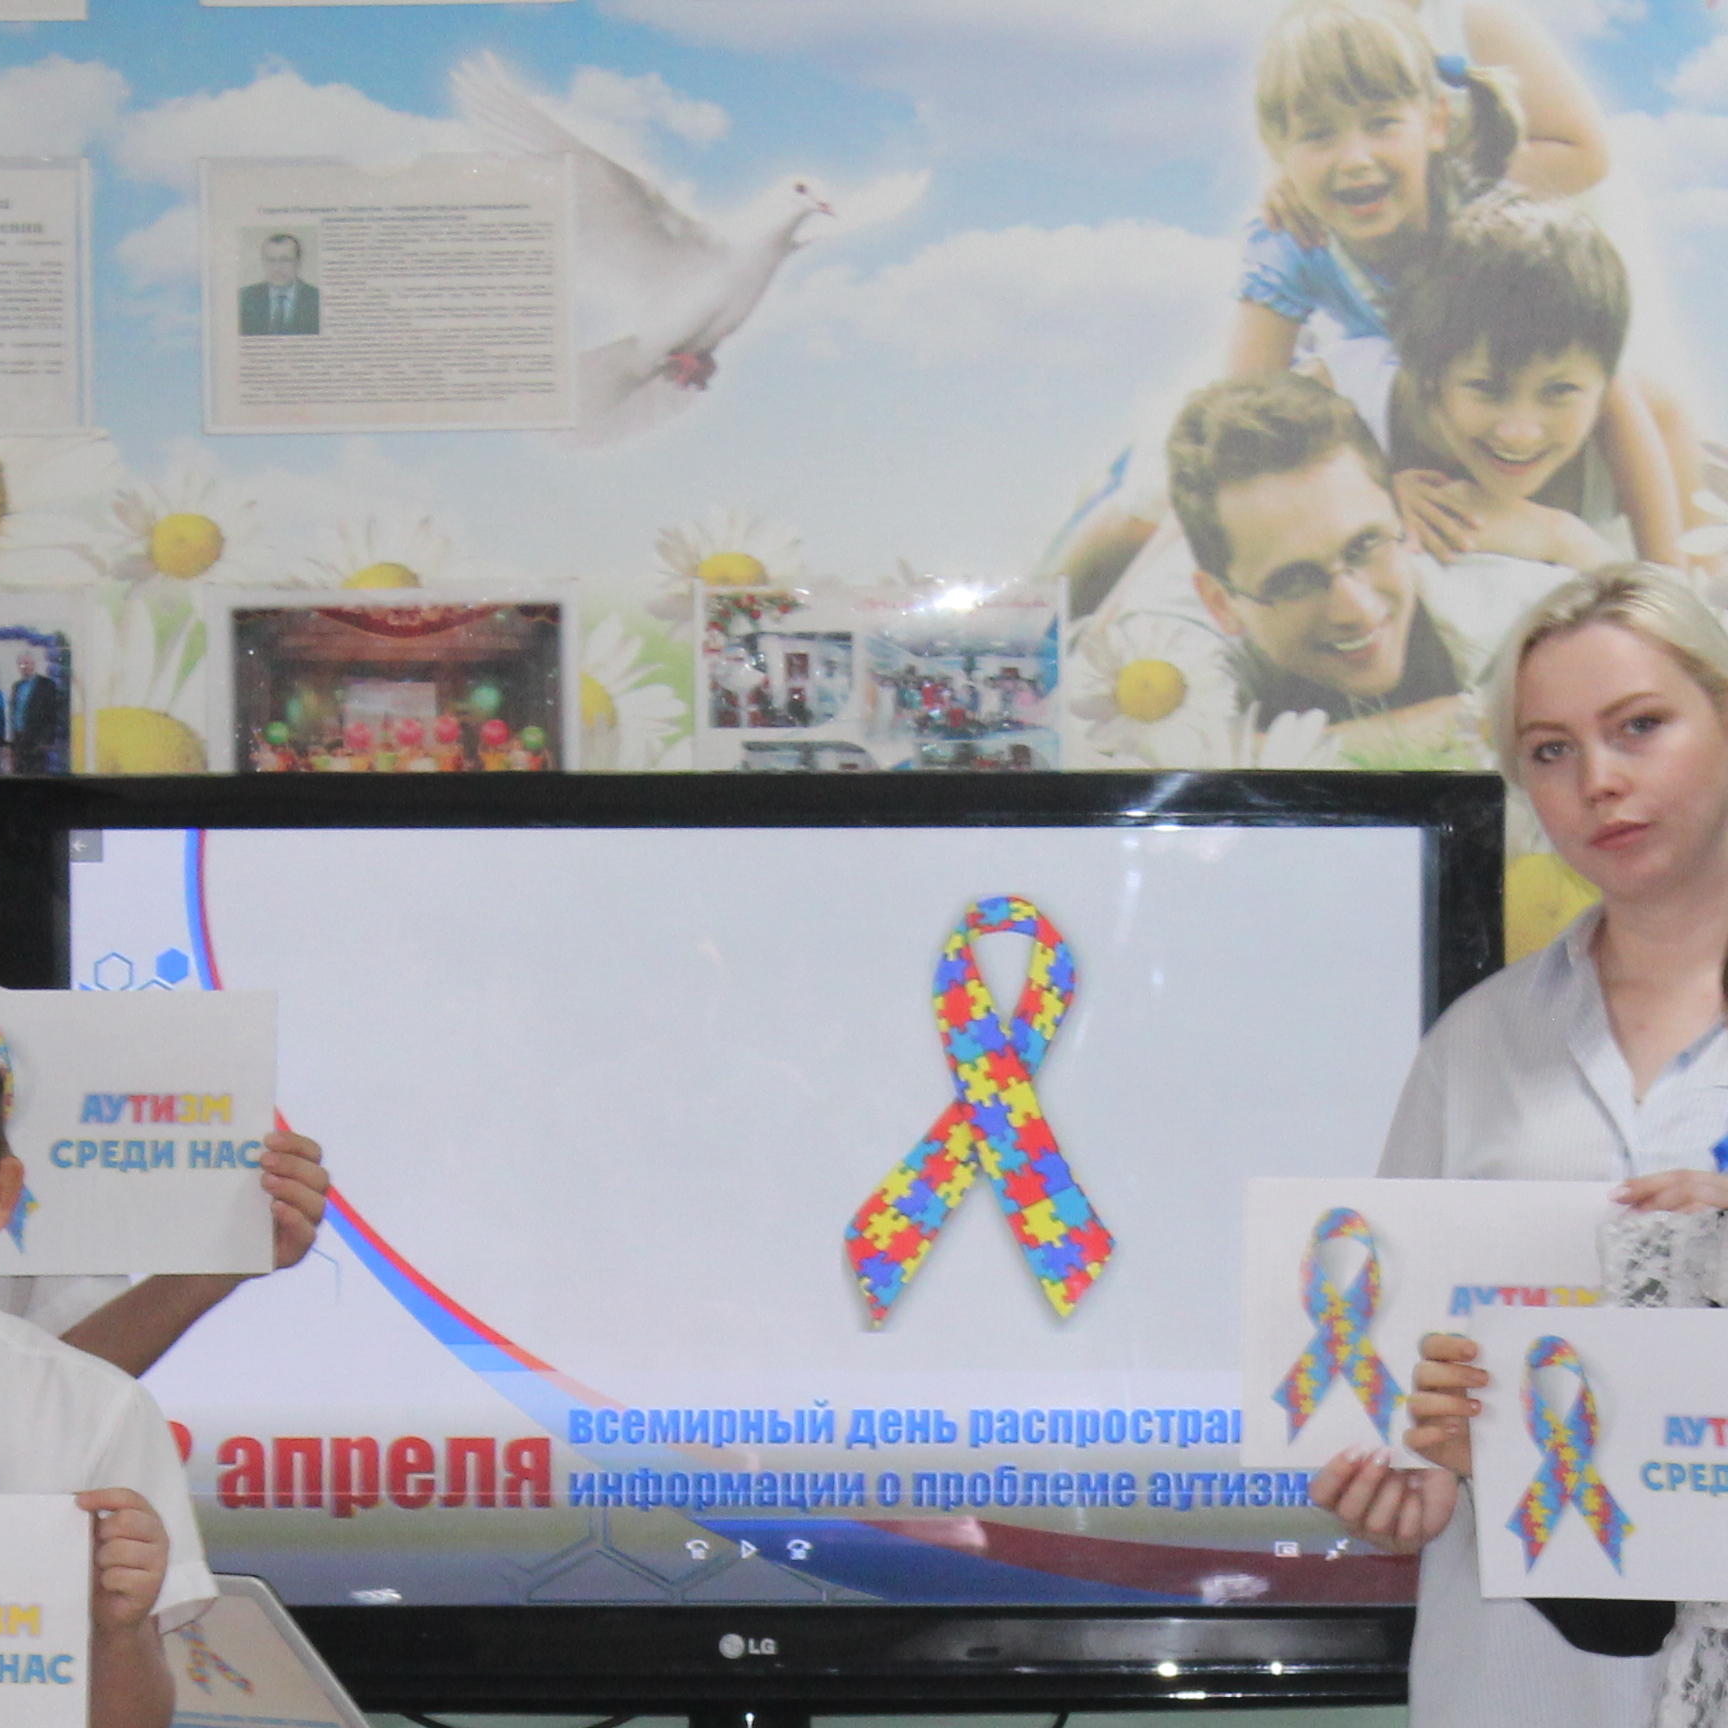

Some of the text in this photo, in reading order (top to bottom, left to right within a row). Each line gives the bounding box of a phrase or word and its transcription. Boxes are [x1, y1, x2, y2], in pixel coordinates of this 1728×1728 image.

[81, 1093, 232, 1124] АУТИЗМ
[50, 1139, 260, 1171] СРЕДИ НАС
[568, 1400, 835, 1448] всемирный
[845, 1407, 959, 1450] день
[215, 1434, 553, 1519] апреля
[568, 1463, 1313, 1513] информации о проблеме аутизм
[747, 1637, 778, 1655] LG
